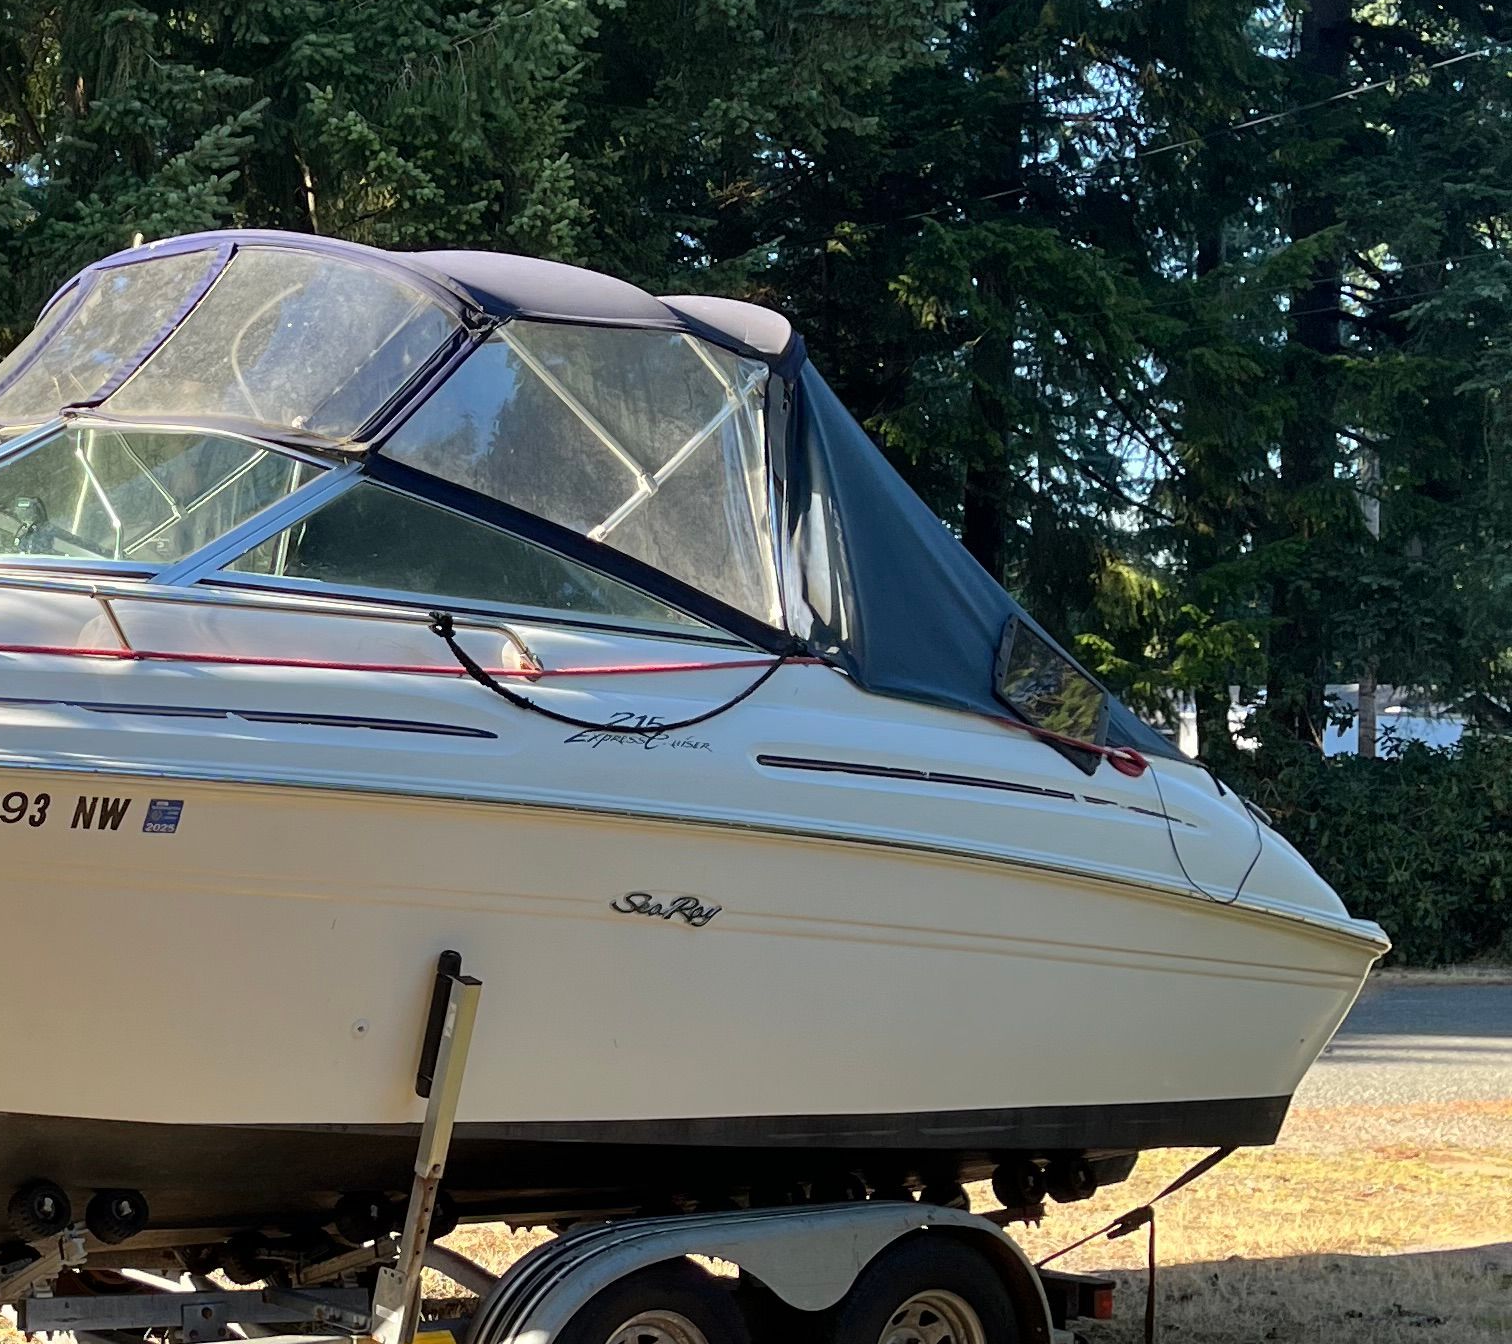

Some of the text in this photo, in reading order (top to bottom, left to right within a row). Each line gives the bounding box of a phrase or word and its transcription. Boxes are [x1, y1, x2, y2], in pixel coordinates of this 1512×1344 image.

[606, 712, 665, 732] 215
[71, 796, 132, 831] NW
[145, 822, 176, 833] 2025
